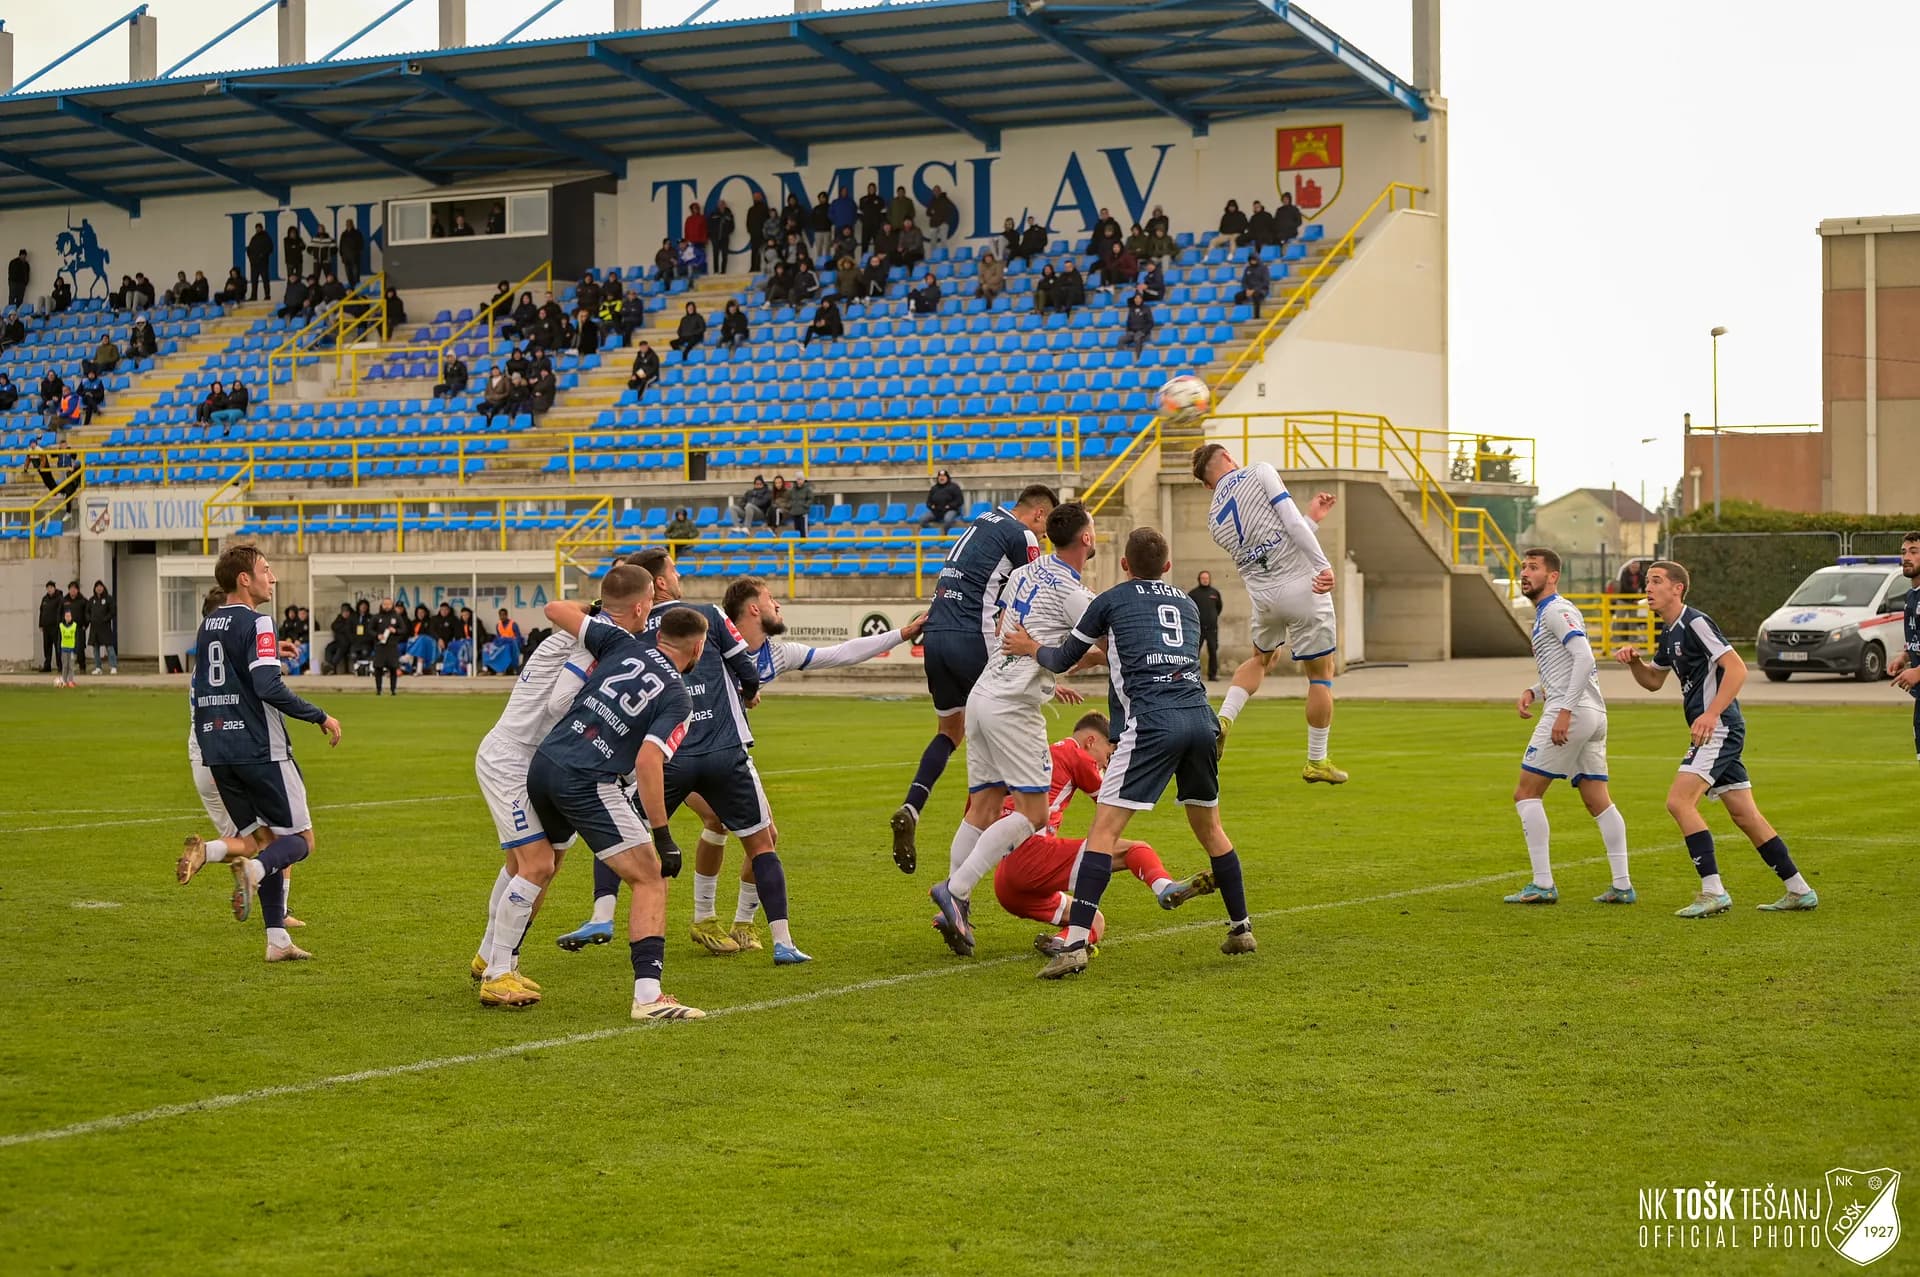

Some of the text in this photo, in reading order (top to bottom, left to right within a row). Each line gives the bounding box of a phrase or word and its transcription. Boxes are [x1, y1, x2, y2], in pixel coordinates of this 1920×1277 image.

[225, 203, 384, 284] HNK
[113, 499, 235, 530] HNK TOMISLAV
[1216, 496, 1244, 549] 7
[947, 526, 977, 562] 11
[1012, 576, 1040, 624] 4
[1136, 585, 1150, 594] D.
[205, 616, 233, 631] VRGOČ
[1157, 604, 1184, 647] 9
[208, 640, 225, 687] 8
[599, 658, 665, 717] 23
[223, 721, 245, 730] 2025
[592, 736, 614, 759] 2025
[512, 809, 529, 832] 2
